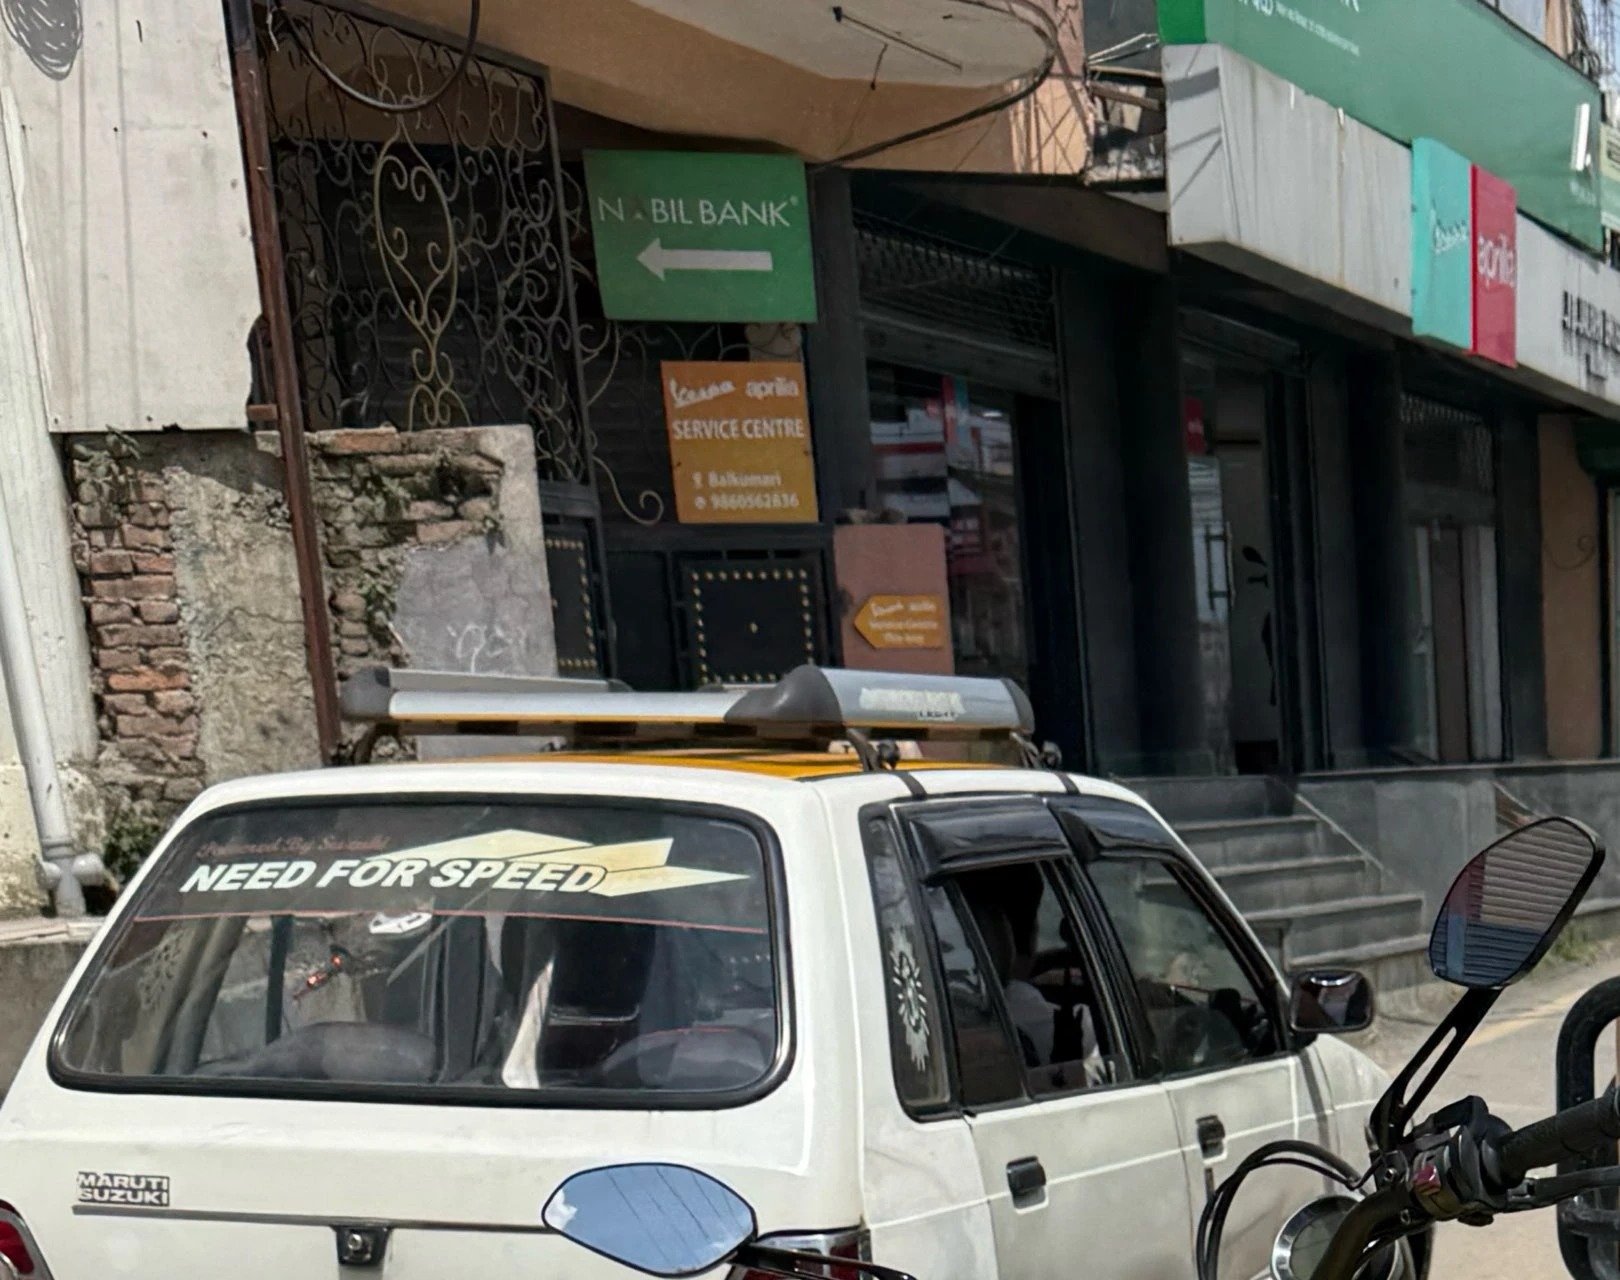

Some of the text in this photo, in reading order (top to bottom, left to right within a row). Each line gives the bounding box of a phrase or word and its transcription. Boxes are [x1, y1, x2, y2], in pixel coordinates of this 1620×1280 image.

[699, 200, 791, 227] BANK
[672, 417, 805, 439] SERVICE CENTRE
[180, 857, 609, 895] NEED FOR SPEED
[78, 1173, 169, 1191] MARUTI
[79, 1187, 169, 1205] SUZUKI
